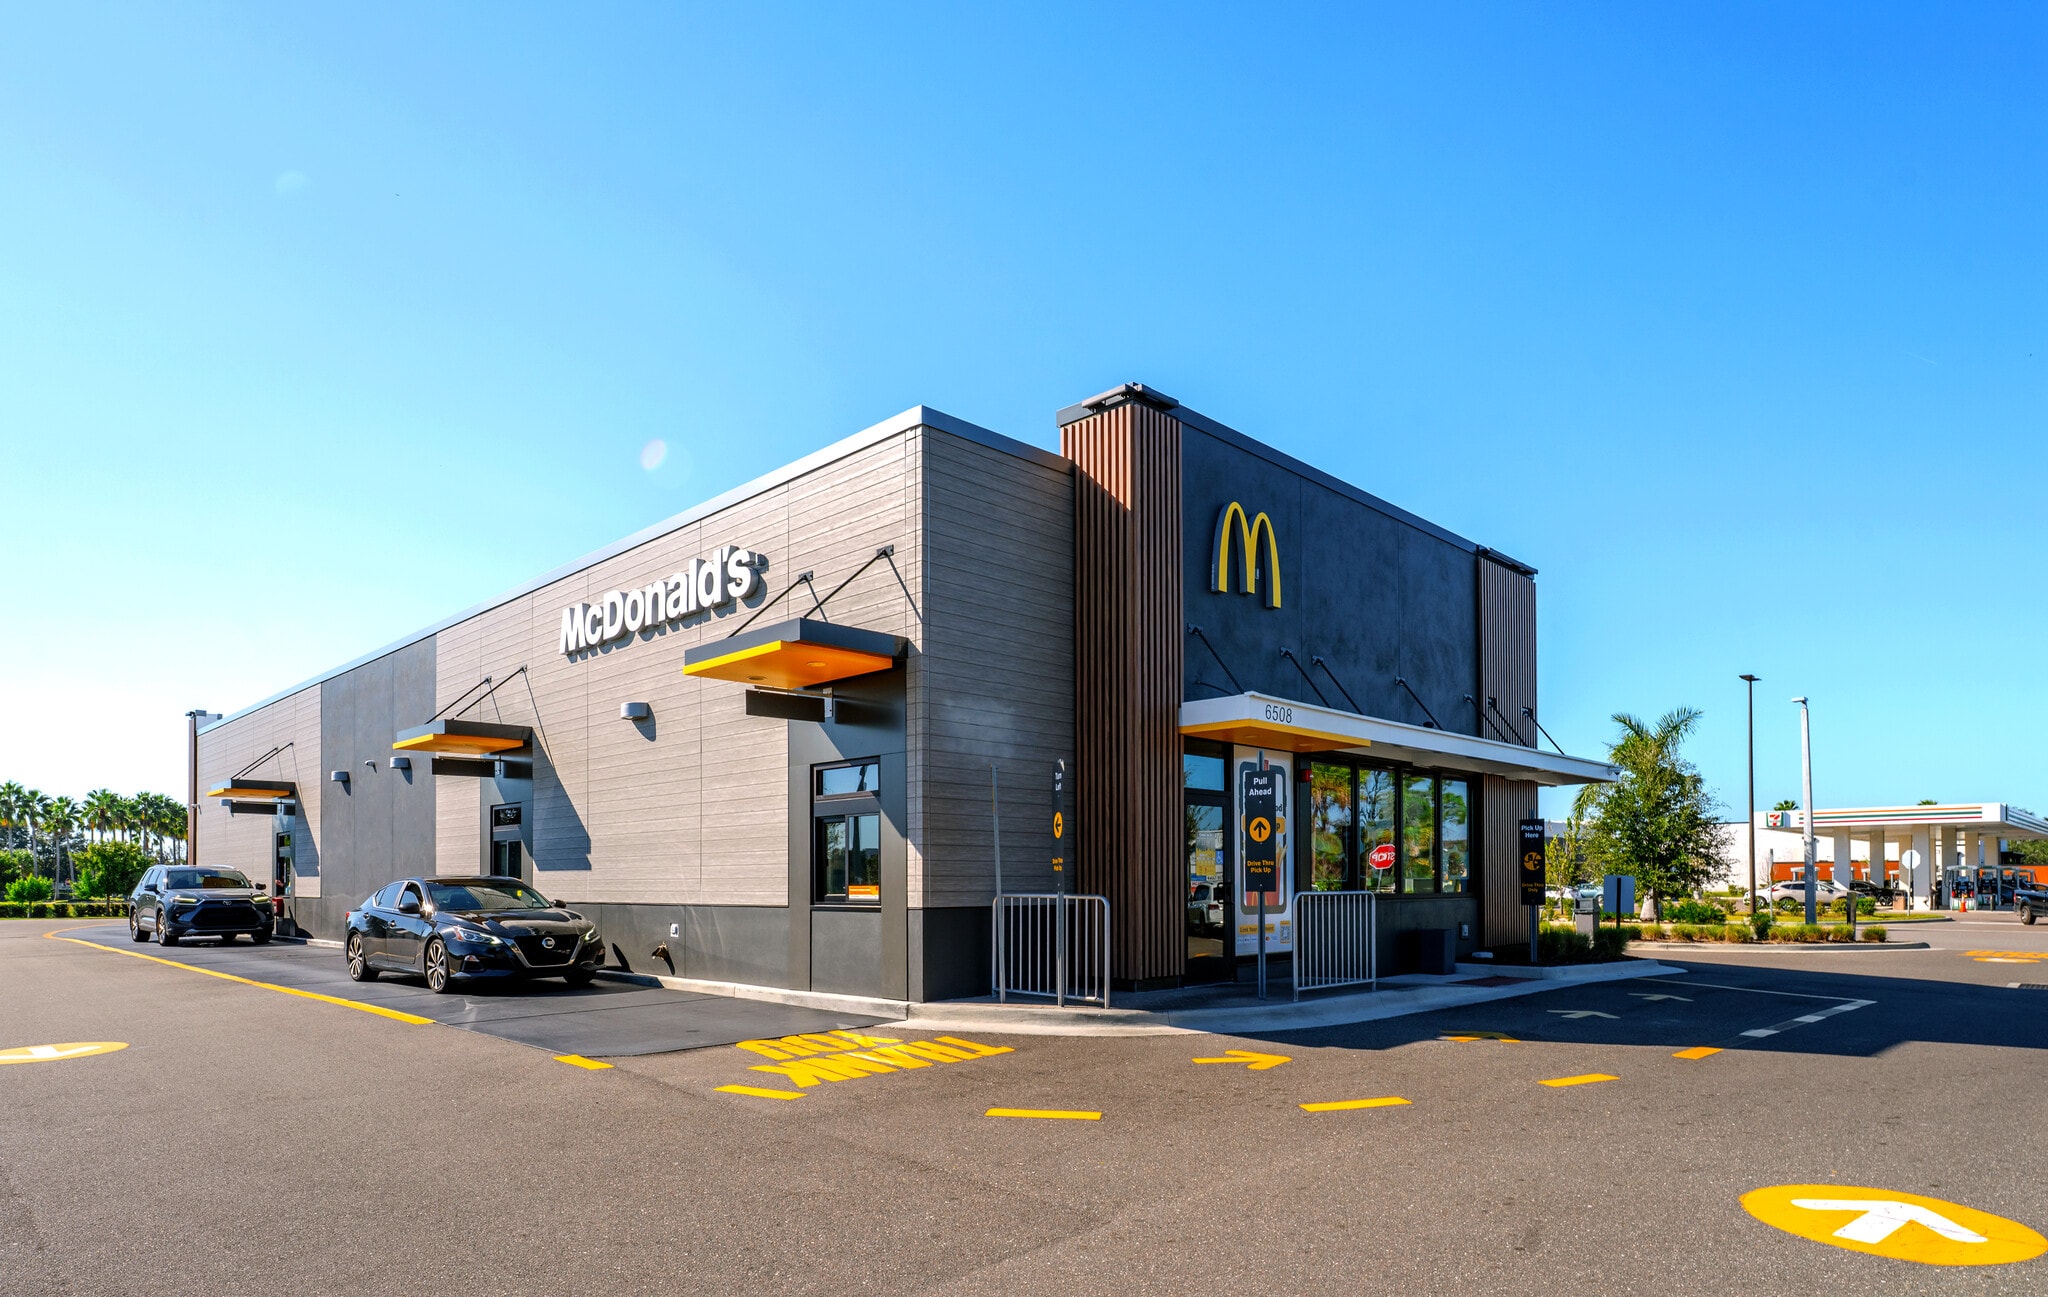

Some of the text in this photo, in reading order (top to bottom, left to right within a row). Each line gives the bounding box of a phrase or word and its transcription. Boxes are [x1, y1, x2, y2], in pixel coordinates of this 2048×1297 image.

[559, 545, 752, 655] McDonald's
[1265, 704, 1292, 724] 6508
[1248, 787, 1272, 796] Ahead
[1253, 776, 1268, 785] Pull
[736, 1030, 904, 1060] YOU
[747, 1036, 1015, 1088] THANK
